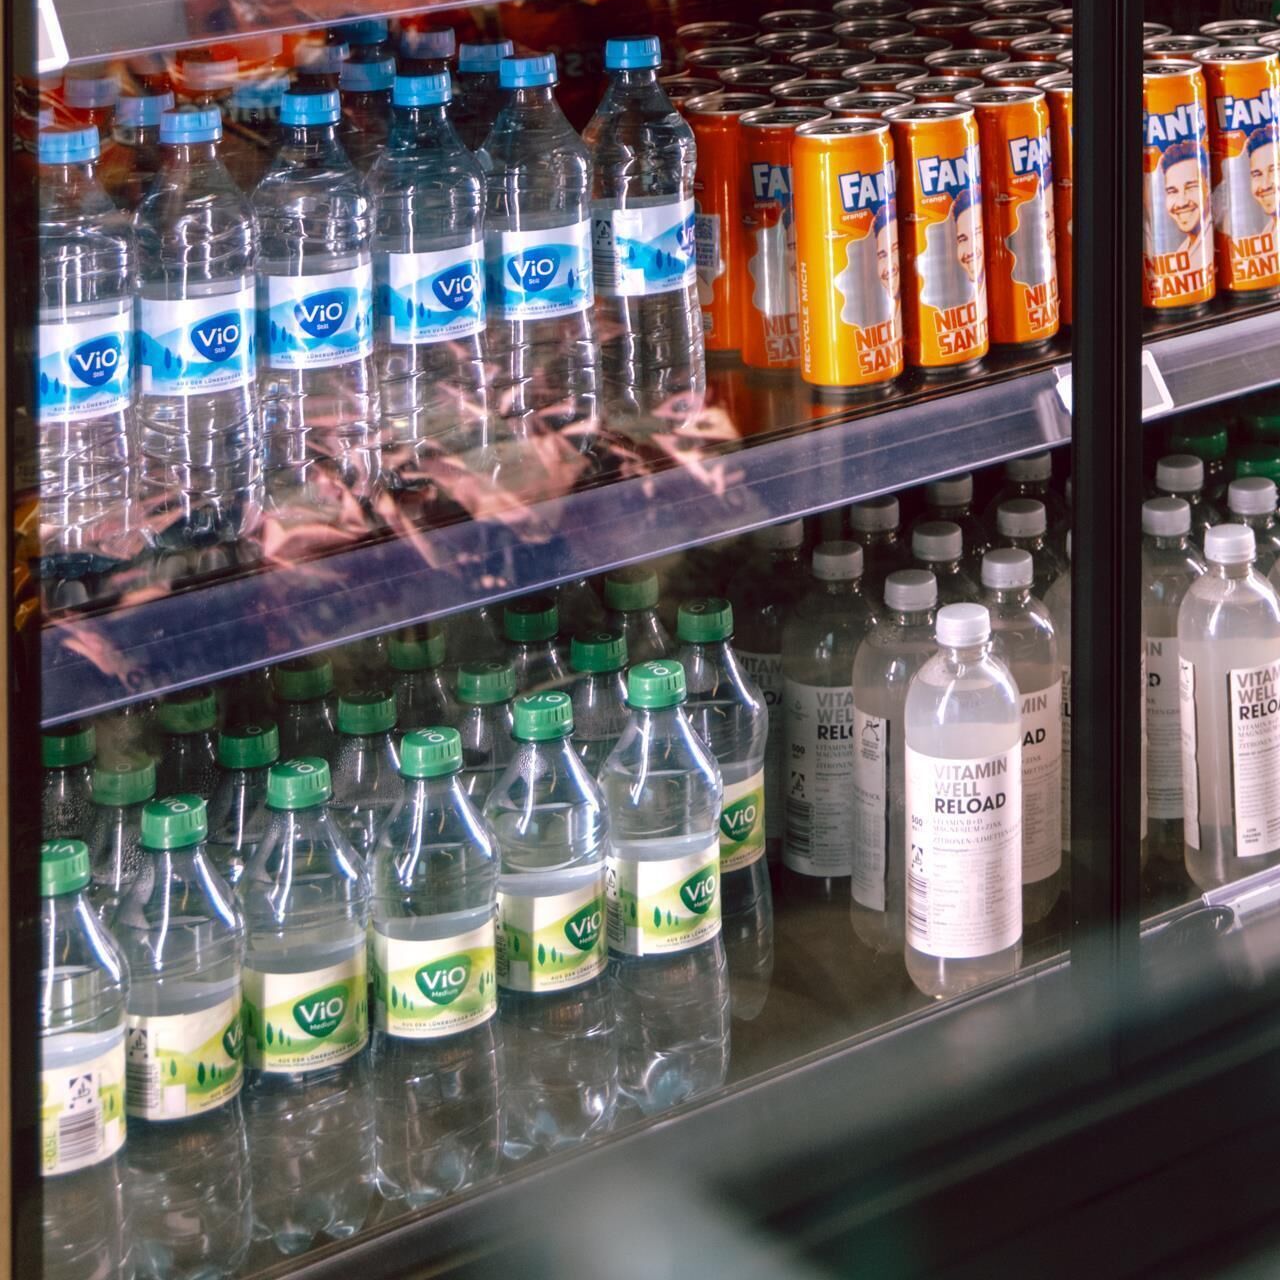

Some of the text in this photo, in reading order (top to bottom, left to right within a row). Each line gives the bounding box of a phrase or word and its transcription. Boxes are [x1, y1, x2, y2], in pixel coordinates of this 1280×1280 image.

[1009, 128, 1052, 173] FAN
[918, 143, 980, 193] FANT
[1012, 174, 1035, 184] orange
[839, 160, 897, 209] FANT
[921, 194, 947, 204] orange
[842, 210, 868, 221] orange
[1230, 232, 1274, 259] NICO
[512, 258, 554, 278] ViO
[1144, 251, 1191, 277] NICO
[437, 273, 475, 296] ViO
[528, 277, 541, 286] Still
[454, 295, 464, 303] Still
[300, 301, 343, 323] ViO
[933, 302, 978, 334] NICO
[1028, 299, 1060, 333] SAN
[197, 324, 239, 347] ViO
[316, 323, 329, 331] Still
[762, 313, 799, 337] NIC
[214, 346, 227, 355] Still
[766, 338, 800, 362] SAN
[803, 306, 811, 374] RECYCLE
[76, 348, 118, 372] ViO
[858, 340, 903, 376] SANT
[92, 370, 105, 379] Still
[817, 691, 853, 708] VITA
[1239, 683, 1277, 705] WELL
[816, 708, 853, 724] WEL
[791, 743, 806, 755] 500
[934, 758, 1008, 781] VITAMIN
[935, 781, 982, 799] WELL
[934, 792, 1007, 815] RELOAD
[724, 804, 756, 830] ViO
[685, 874, 716, 902] ViO
[421, 966, 466, 990] ViO
[298, 997, 343, 1022] ViO
[309, 1020, 336, 1032] Medium
